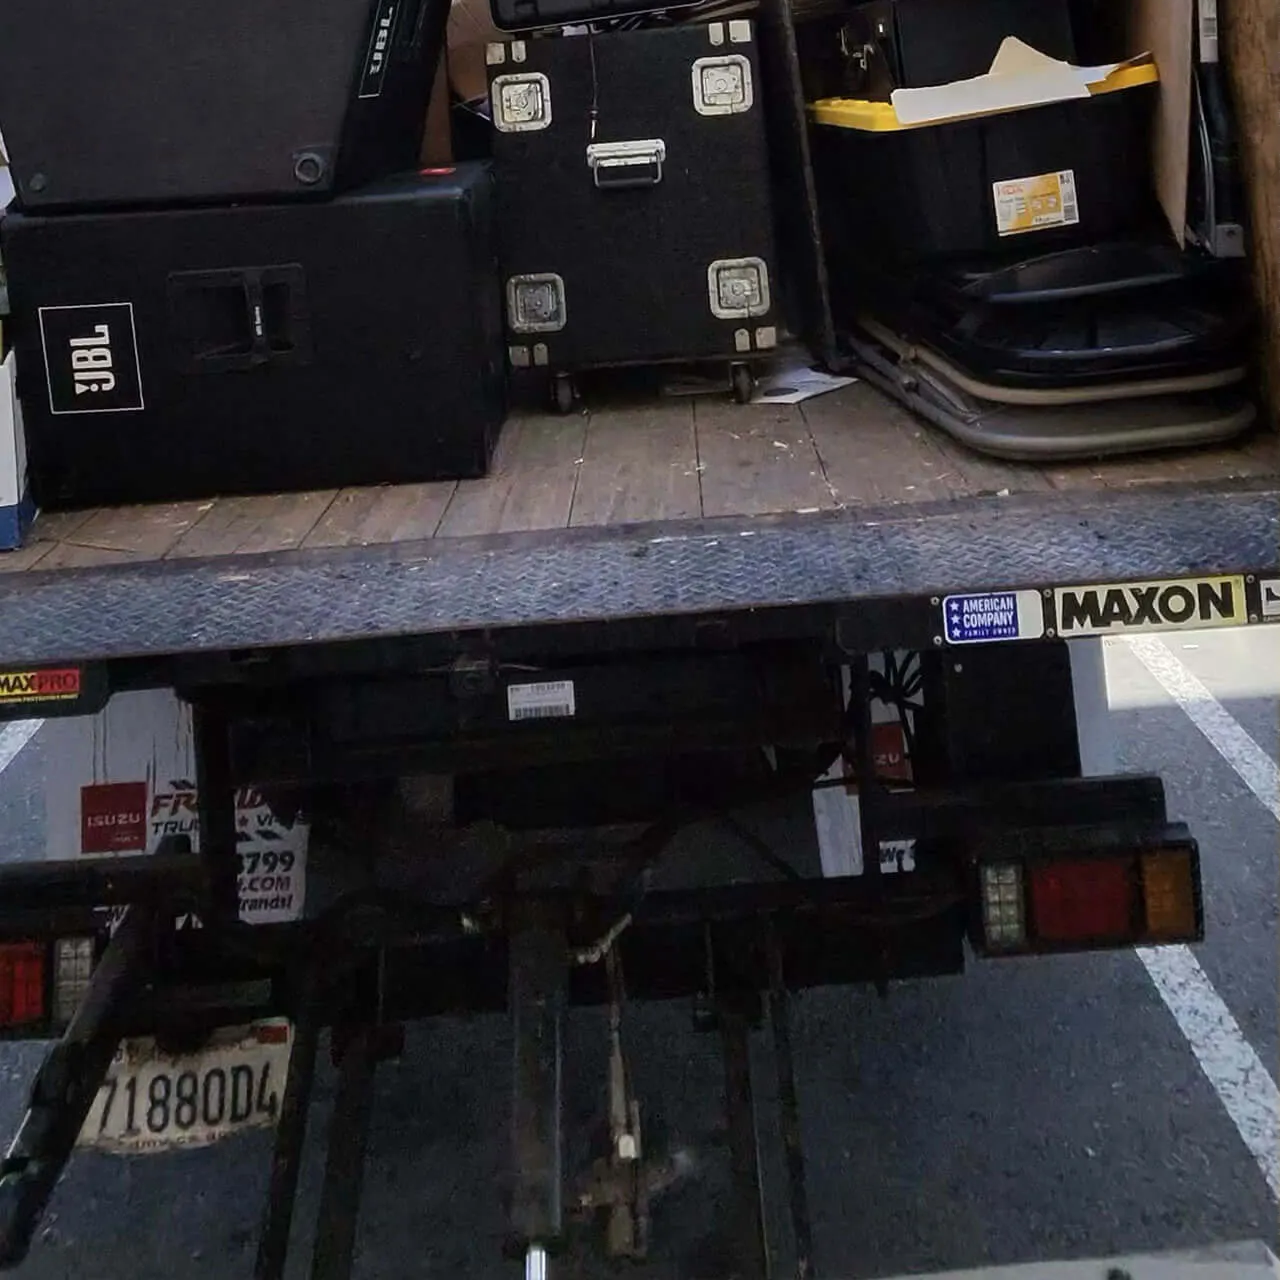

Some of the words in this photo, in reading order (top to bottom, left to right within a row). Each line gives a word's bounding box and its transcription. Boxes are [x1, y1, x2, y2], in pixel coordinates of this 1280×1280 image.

[369, 6, 394, 75] JBL
[70, 324, 115, 395] JBL
[963, 597, 1015, 614] AMERICAN
[963, 611, 1015, 629] COMPANY
[1061, 581, 1236, 631] MAXON
[87, 812, 141, 828] ISUZU
[238, 893, 294, 913] rands!
[99, 1061, 278, 1134] 71880D4
